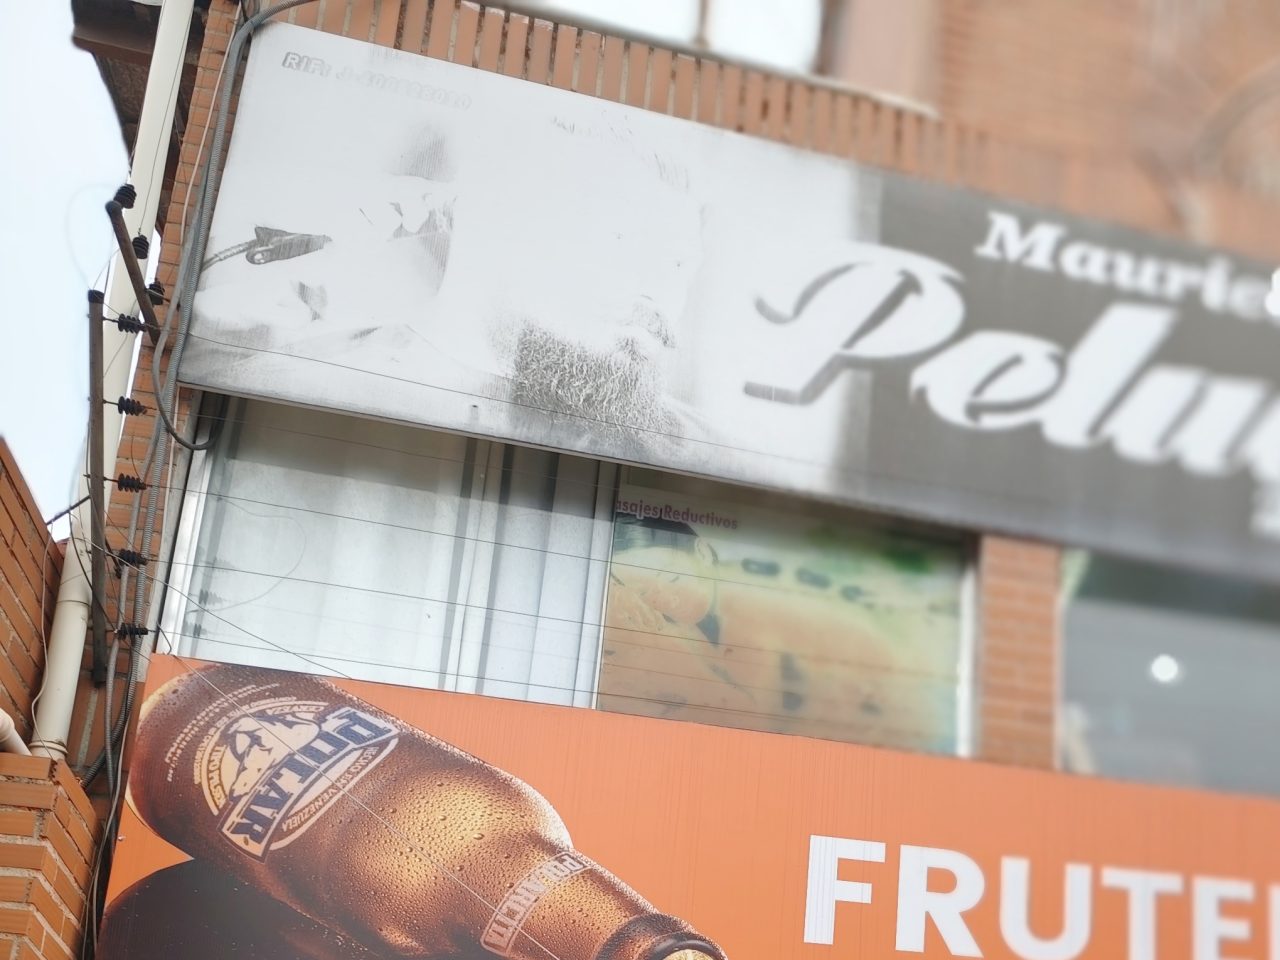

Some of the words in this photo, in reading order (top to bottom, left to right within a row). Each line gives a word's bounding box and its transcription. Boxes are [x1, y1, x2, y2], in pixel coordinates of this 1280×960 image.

[662, 504, 739, 530] Reductivos
[229, 709, 394, 846] POLAR
[281, 787, 339, 833] VENEZUELA
